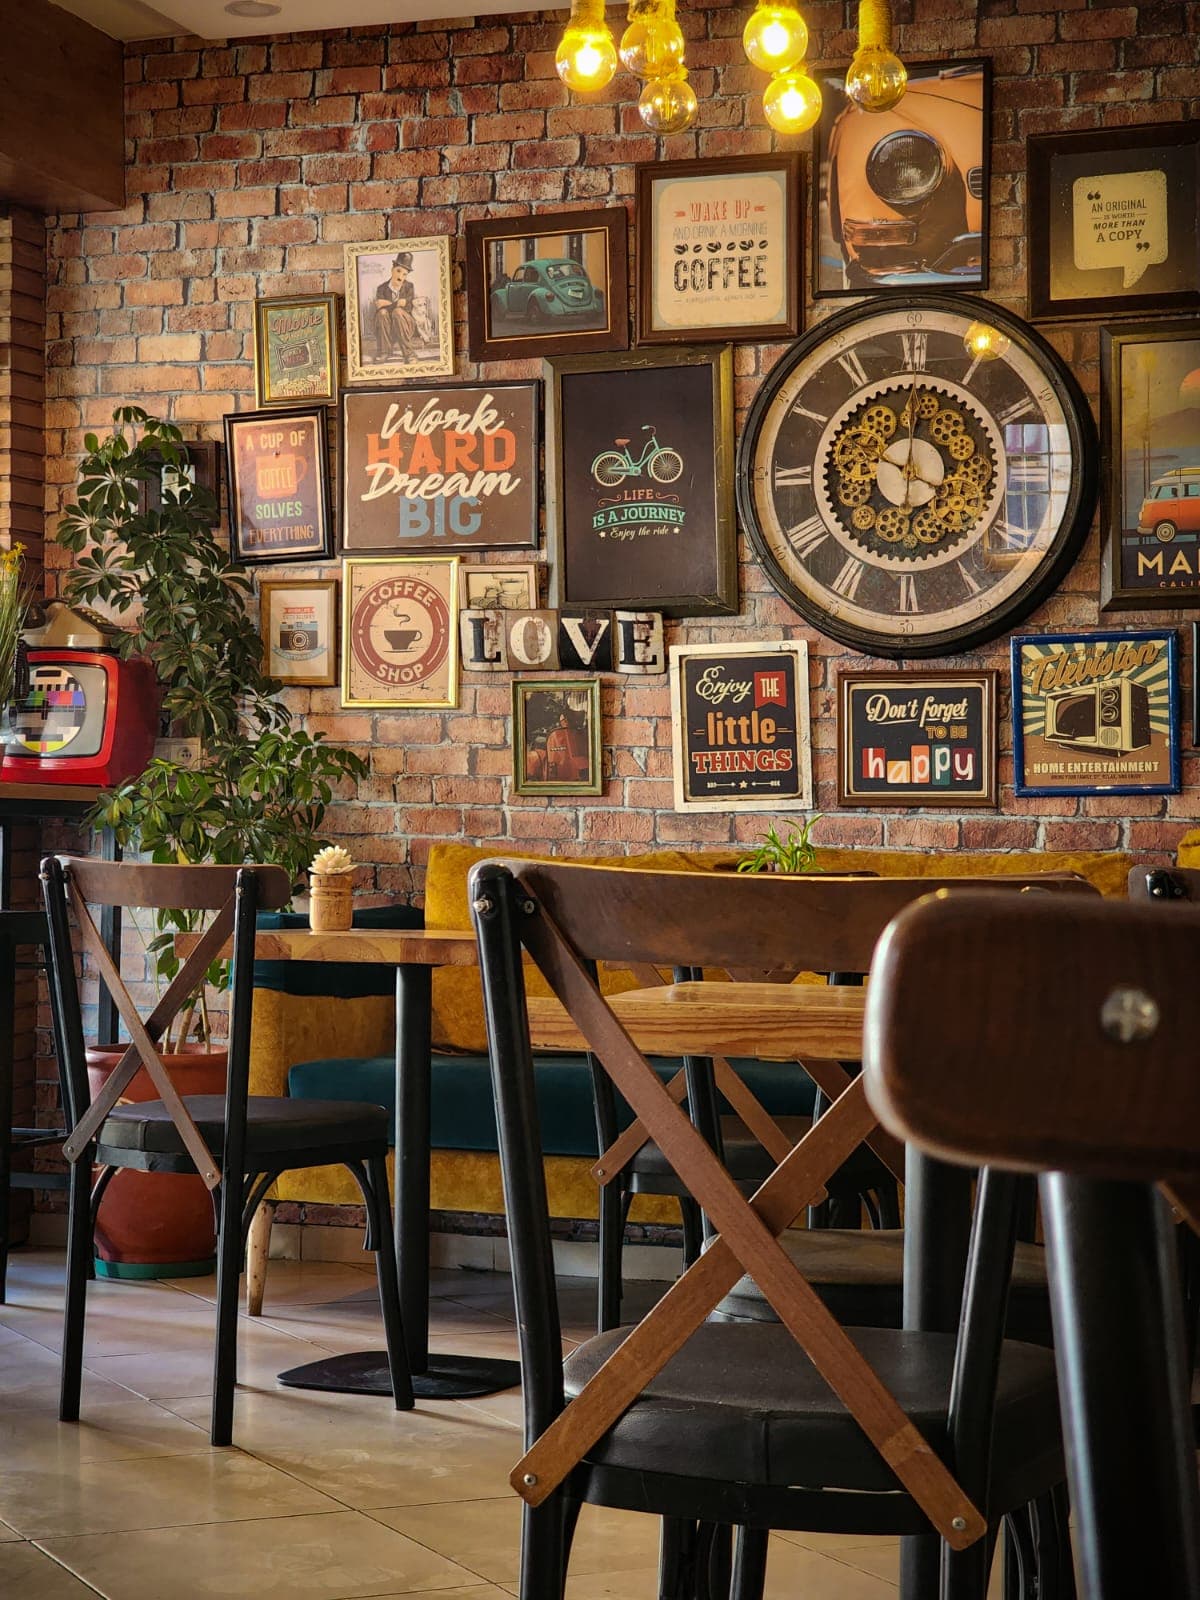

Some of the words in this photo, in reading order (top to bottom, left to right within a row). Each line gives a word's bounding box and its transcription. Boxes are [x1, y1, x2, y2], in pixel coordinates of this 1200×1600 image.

[691, 201, 728, 222] WAKE
[735, 200, 750, 219] UP
[1092, 202, 1103, 213] AN
[1105, 198, 1147, 212] ORIGINAL
[673, 226, 690, 241] AND
[720, 224, 727, 237] A
[729, 222, 768, 236] MORNING
[1093, 221, 1119, 230] MORE
[1122, 219, 1146, 228] THAN
[1096, 232, 1105, 243] A
[1109, 229, 1142, 241] COPY
[674, 255, 767, 291] COFFEE
[906, 312, 922, 324] 60
[381, 393, 505, 439] Work
[245, 434, 254, 450] A
[260, 432, 284, 449] CUP
[290, 430, 306, 447] OF
[366, 428, 517, 476] HARD
[361, 462, 522, 501] Dream
[624, 489, 654, 500] LIFE
[255, 501, 303, 519] SOLVES
[398, 495, 483, 538] BIG
[592, 513, 605, 528] IS
[608, 510, 618, 523] A
[621, 507, 686, 522] JOURNEY
[248, 524, 314, 544] EVERYTHING
[610, 527, 636, 541] Enjoy
[638, 526, 650, 537] the
[653, 525, 669, 535] ride
[1138, 548, 1200, 576] MA
[369, 581, 437, 607] COFFEE
[467, 616, 658, 665] LOVE
[377, 663, 424, 682] SHOP
[1022, 643, 1160, 694] Television
[695, 665, 753, 704] Enjoy
[760, 678, 780, 697] THE
[865, 694, 919, 722] Don't
[919, 696, 968, 728] forget
[707, 710, 776, 745] little
[926, 725, 947, 739] TO
[950, 725, 968, 739] BE
[692, 748, 793, 773] THINGS
[867, 747, 975, 783] happy
[1033, 762, 1065, 774] HOME
[1067, 760, 1159, 773] ENTERTAINMENT
